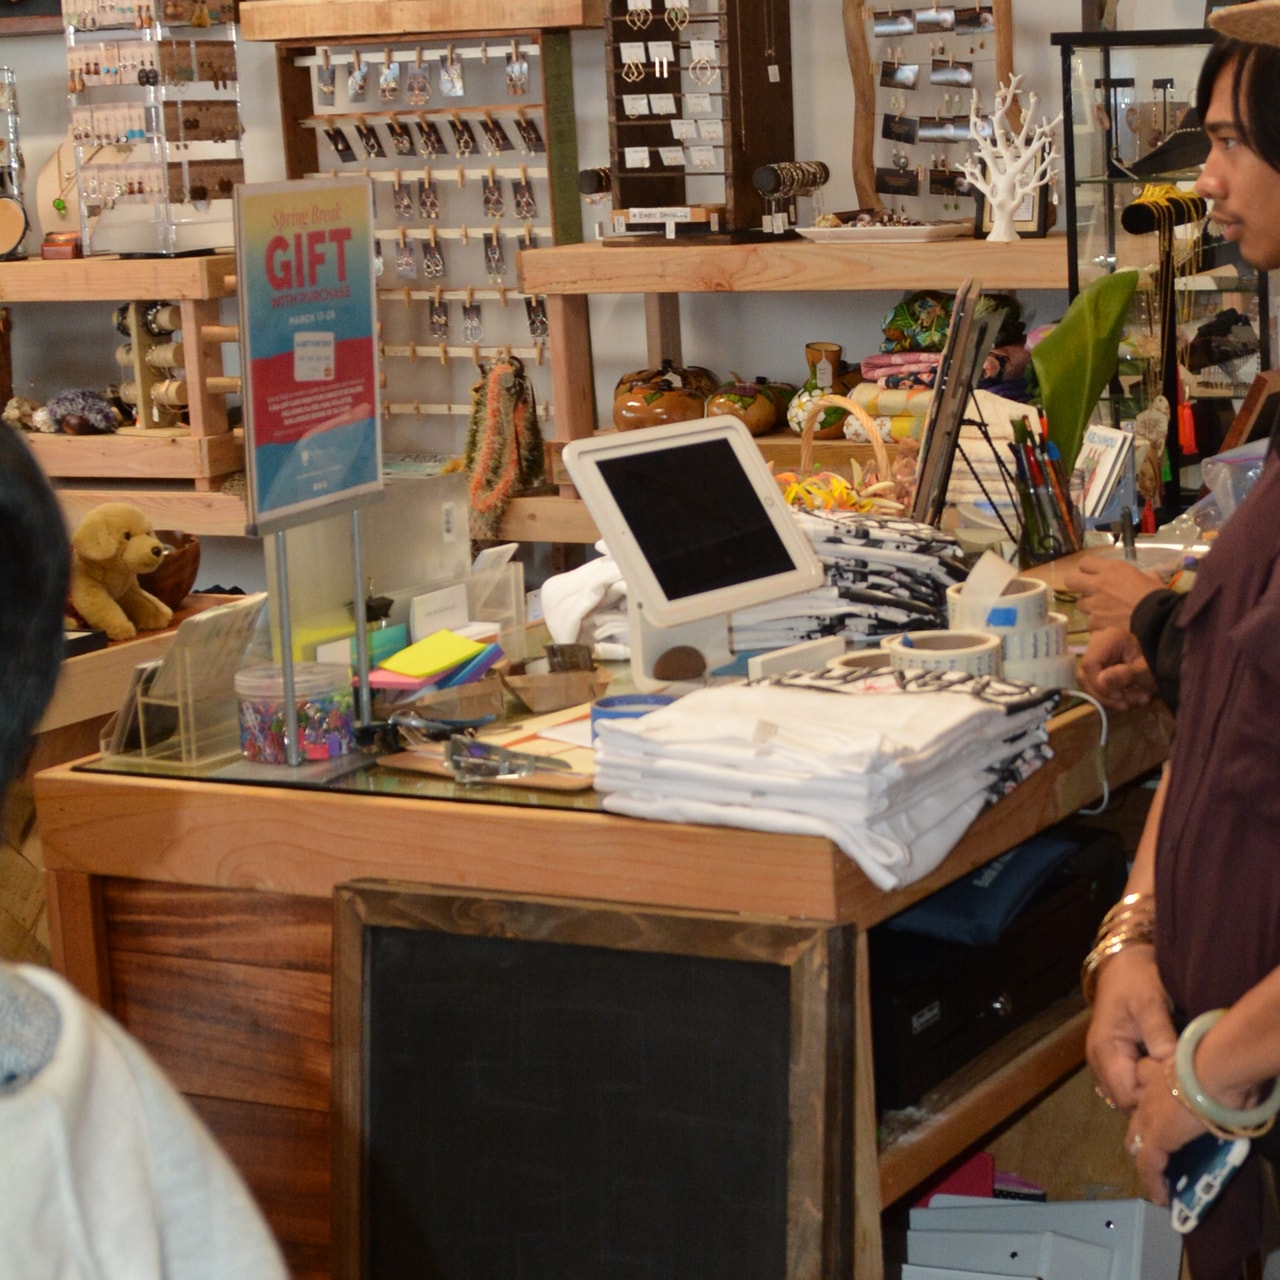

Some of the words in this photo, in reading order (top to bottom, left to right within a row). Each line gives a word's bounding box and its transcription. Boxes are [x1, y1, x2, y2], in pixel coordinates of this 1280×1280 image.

[271, 208, 308, 231] Spring
[312, 202, 341, 223] Break
[264, 227, 352, 291] GIFT
[271, 293, 297, 309] WITH
[299, 285, 350, 303] PURCHASE
[288, 314, 315, 325] MARCH
